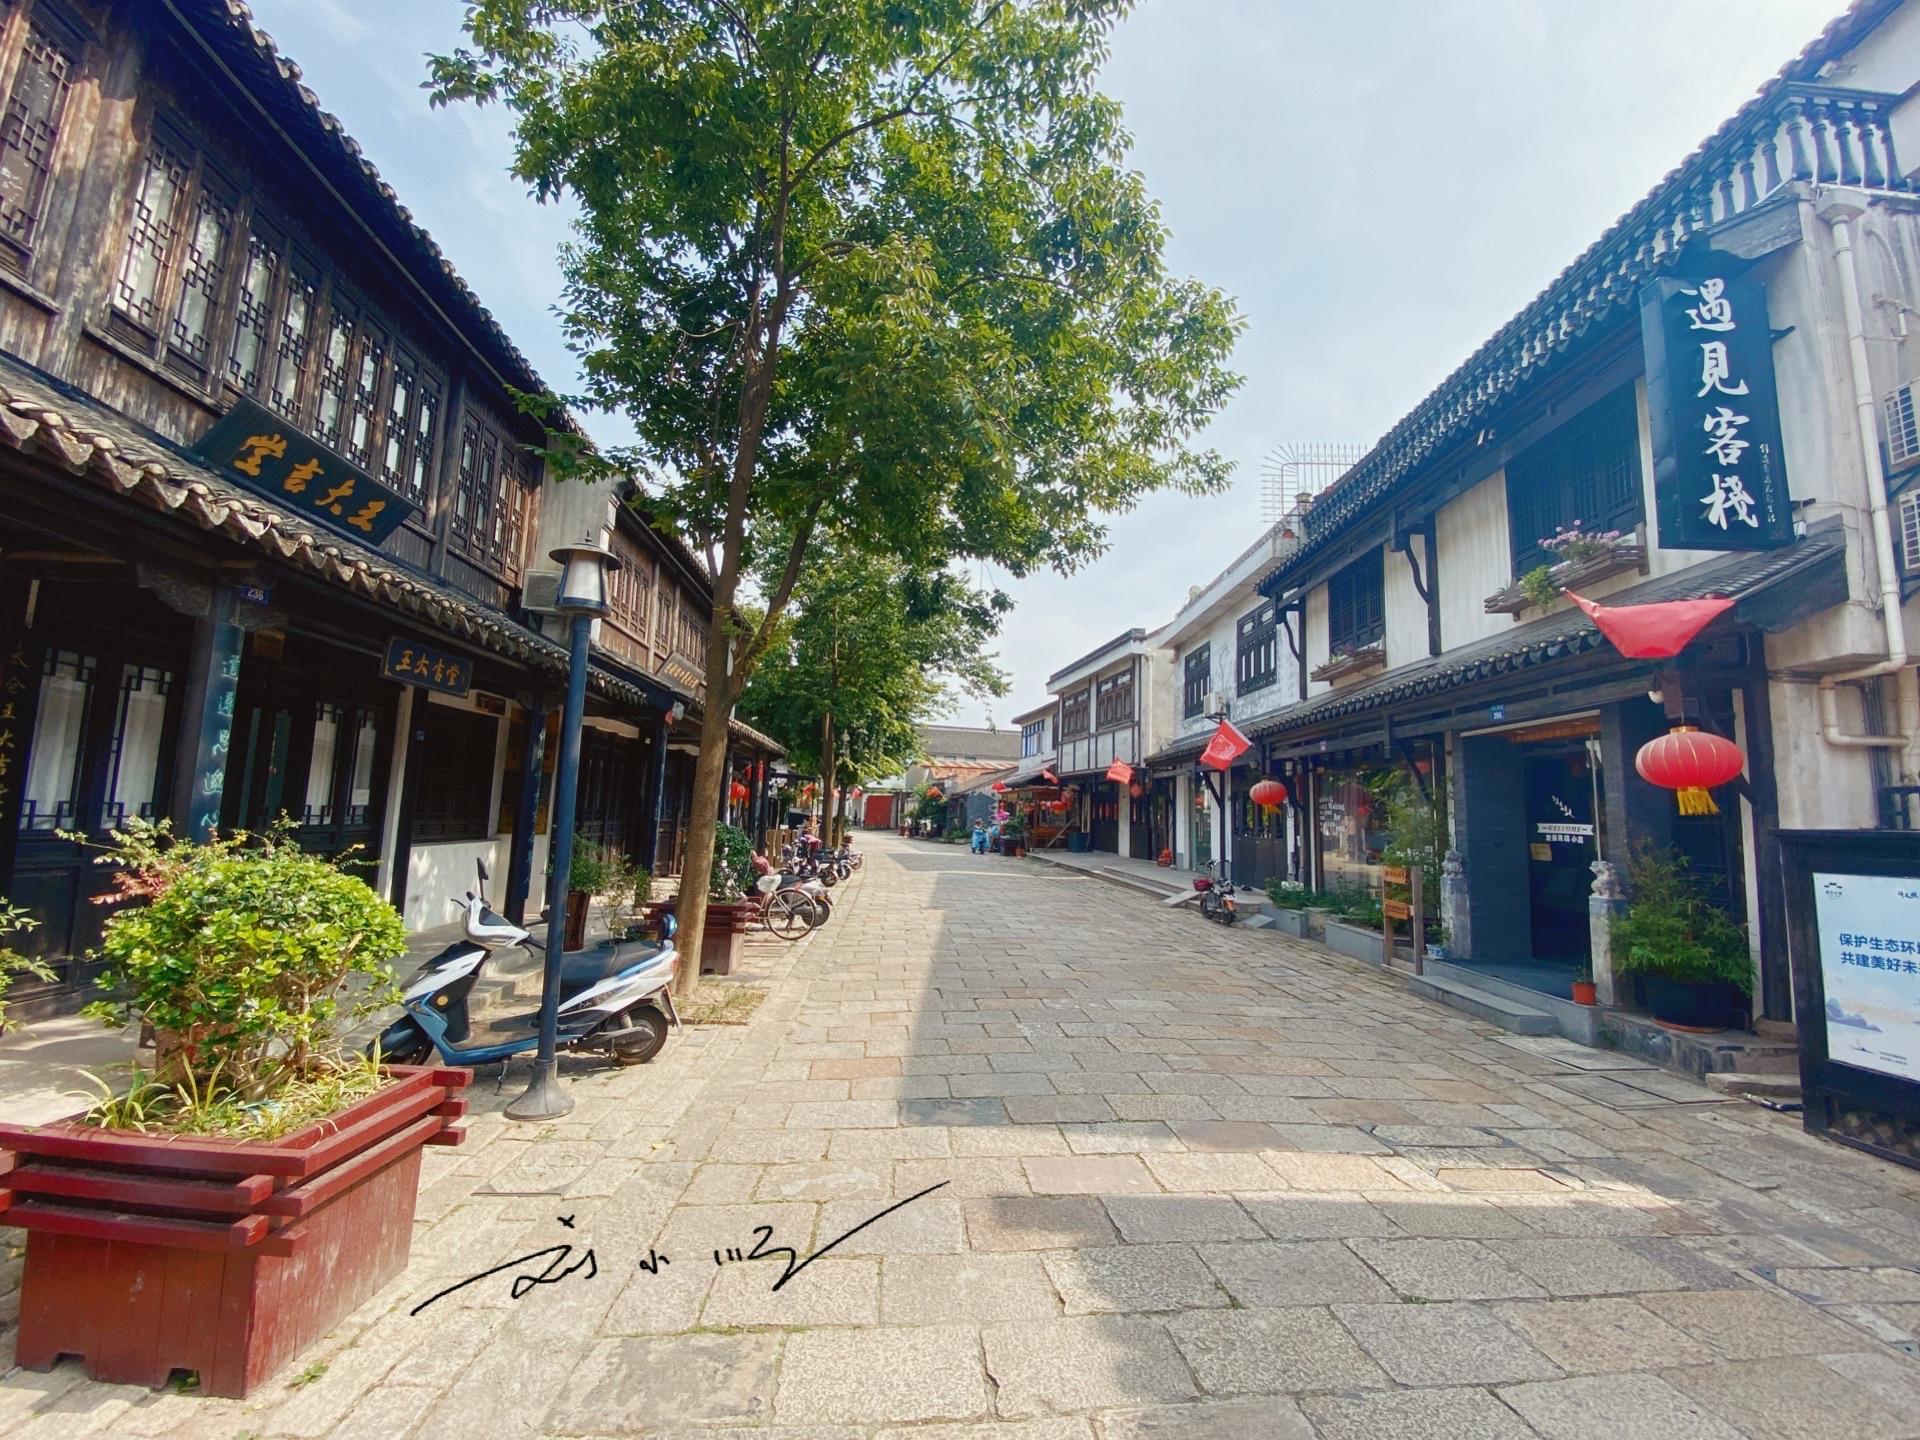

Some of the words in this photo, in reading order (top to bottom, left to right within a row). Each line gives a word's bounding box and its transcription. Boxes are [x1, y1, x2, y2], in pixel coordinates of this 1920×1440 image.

[247, 588, 264, 601] 236
[1547, 825, 1582, 833] WELCOME
[1840, 951, 1920, 975] 共建美好未
